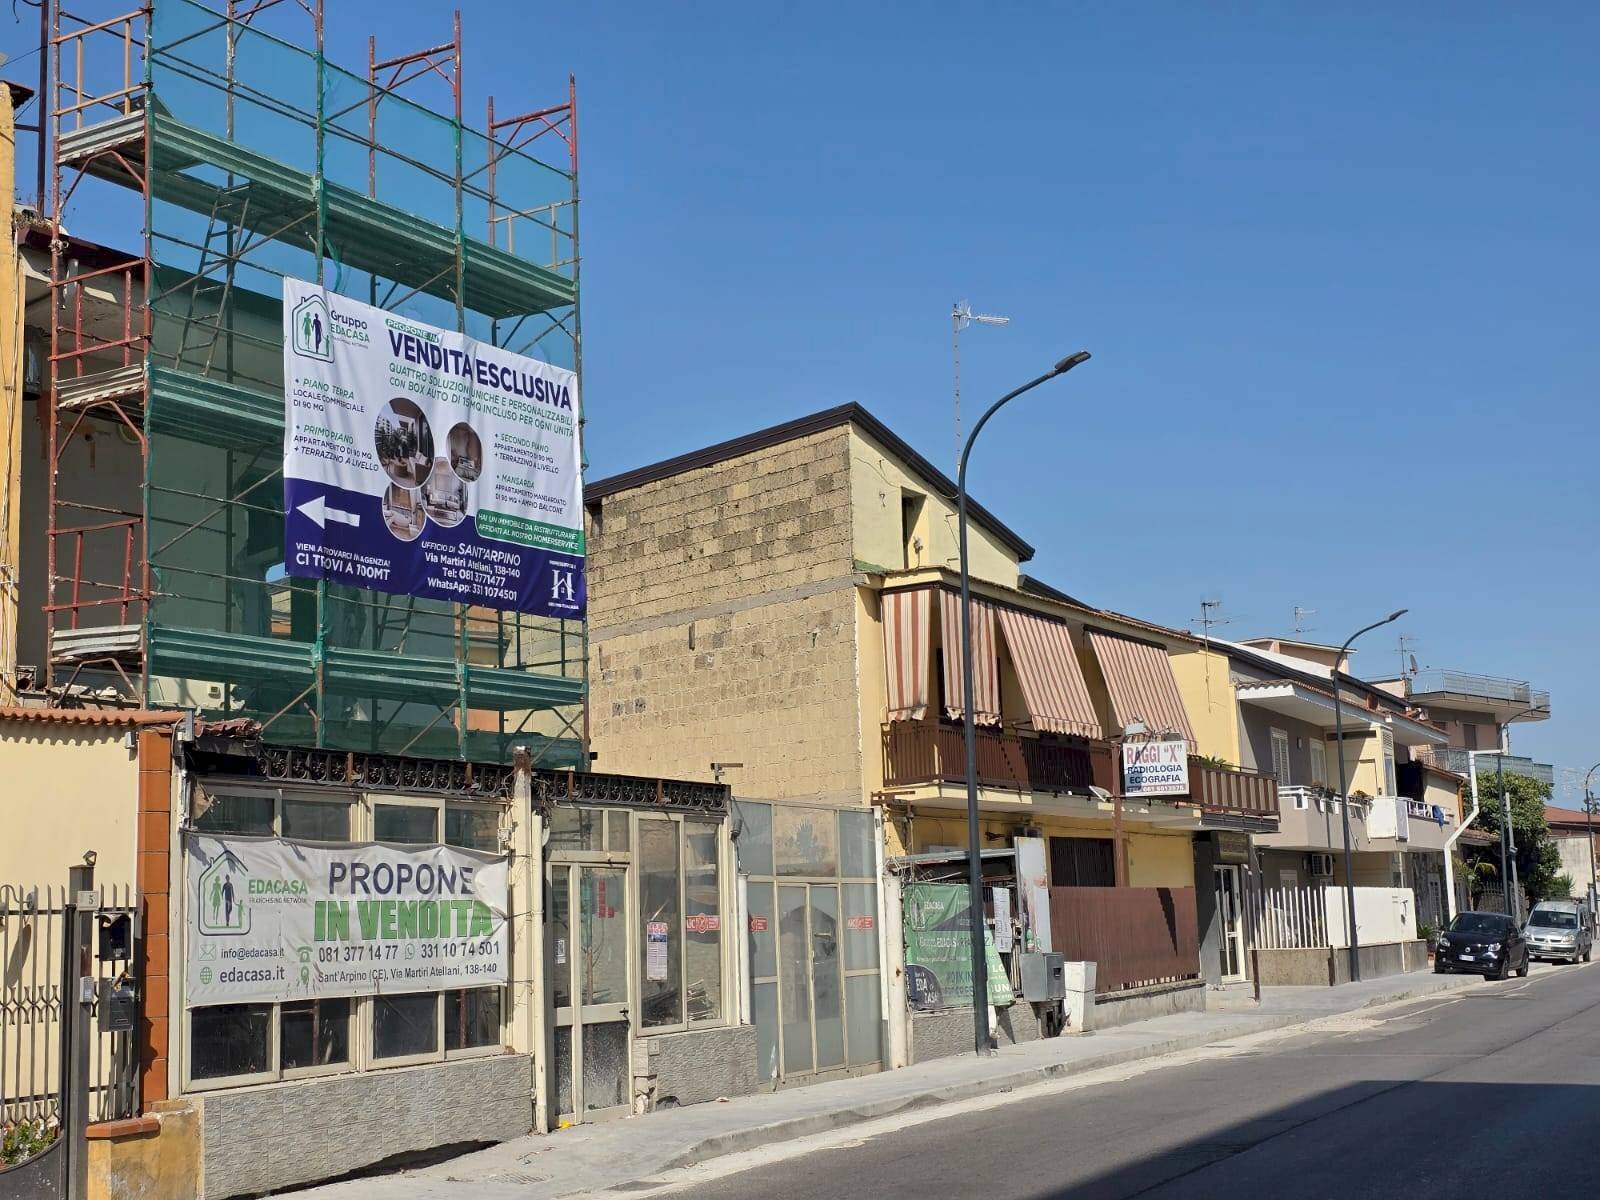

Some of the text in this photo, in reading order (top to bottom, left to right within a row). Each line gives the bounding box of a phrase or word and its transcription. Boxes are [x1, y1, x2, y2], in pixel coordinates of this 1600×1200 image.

[331, 310, 368, 330] Gruppo
[387, 320, 428, 339] PROPONE
[330, 324, 369, 342] EDACASA
[388, 329, 572, 412] VENDITA ESCLUSIVA
[293, 388, 321, 400] LOCALE
[303, 378, 354, 400] PIANO TERRA
[390, 362, 427, 382] QUATTRO
[502, 397, 506, 406] E
[509, 399, 572, 426] PERSONALIZZABILI
[390, 376, 406, 389] CON
[408, 381, 426, 394] BOX
[427, 388, 448, 402] AUTO
[452, 393, 460, 404] DI
[484, 404, 517, 421] INCLUSO
[520, 413, 533, 426] PER
[535, 418, 552, 432] OGNI
[296, 542, 316, 552] VIENI
[421, 540, 448, 552] UFFICIO
[458, 542, 521, 566] SANT'ARPINO
[296, 552, 309, 566] CI
[345, 562, 354, 575] A
[356, 564, 390, 580] 100MT
[424, 552, 438, 562] Via
[440, 554, 466, 567] Martiri
[442, 567, 458, 578] Tel:
[428, 577, 518, 601] WhatsApp: 331 1074501
[1126, 744, 1160, 764] RAGGI
[1128, 764, 1182, 774] RADIOLOGIA
[1130, 774, 1180, 784] ECOGRAFIA
[248, 880, 308, 895] EDACASA
[329, 862, 474, 895] PROPONE
[314, 900, 493, 942] IN VENDITA
[221, 948, 284, 960] info@edacasa.it
[318, 944, 398, 962] 081 377 14 77
[421, 941, 500, 958] 331 10 74 501
[220, 966, 284, 982] edacasa.it
[318, 970, 366, 984] Sant'Arpino
[391, 968, 403, 979] Via
[404, 966, 428, 978] Martiri
[430, 964, 462, 977] Atellani,
[465, 962, 497, 975] 138-140
